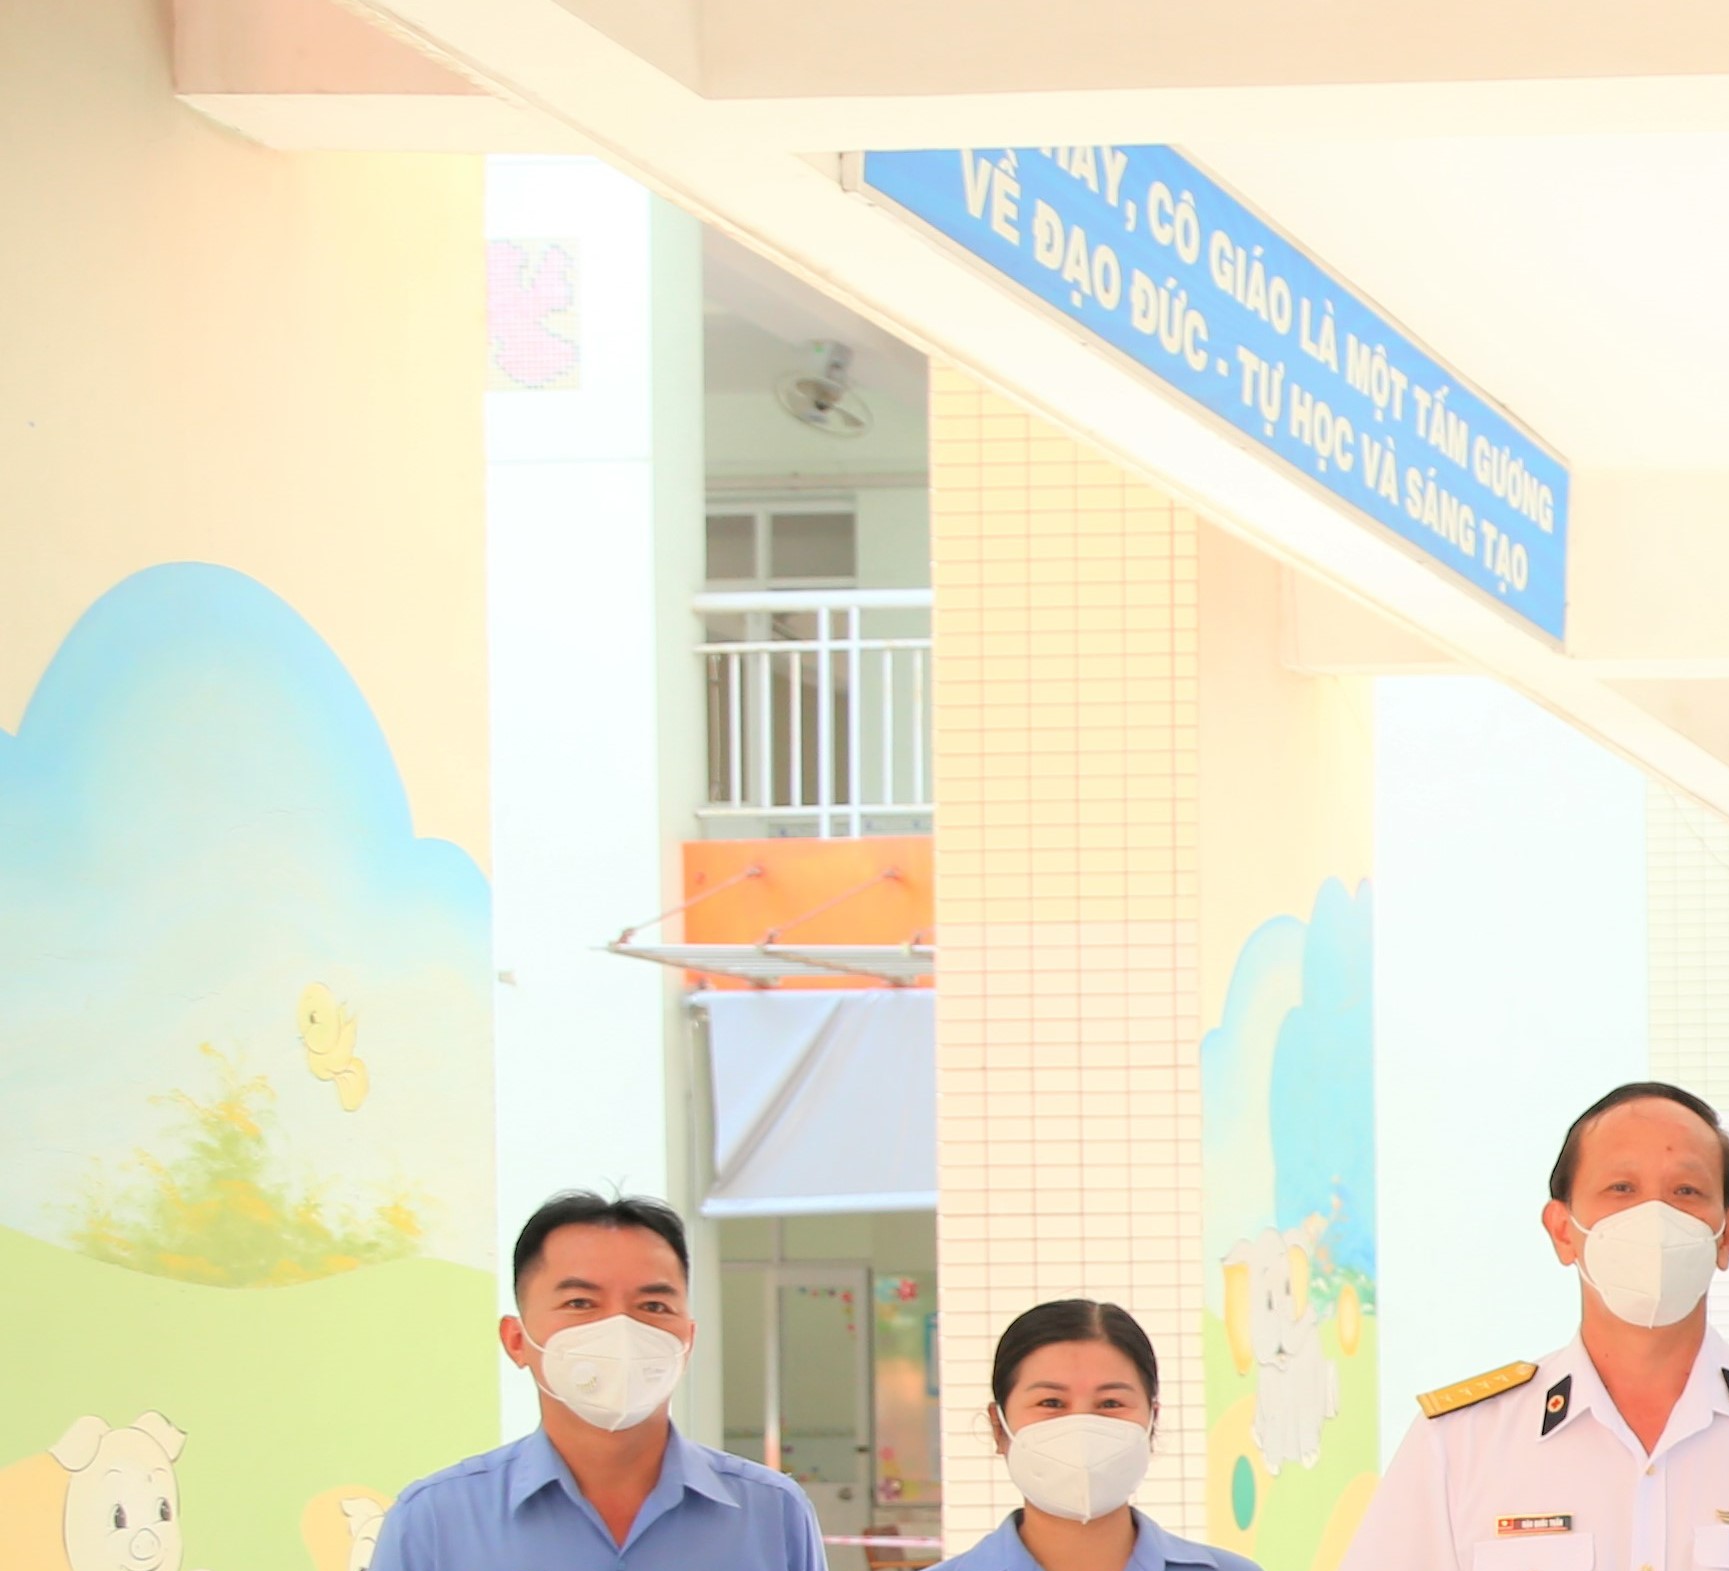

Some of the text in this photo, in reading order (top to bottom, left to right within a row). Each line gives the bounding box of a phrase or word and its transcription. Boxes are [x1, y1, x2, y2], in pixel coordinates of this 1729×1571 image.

[962, 148, 1020, 246] VỀ
[1033, 198, 1122, 311] ĐẠO
[1130, 268, 1209, 371] ĐỨC
[1237, 345, 1285, 437] TỰ
[1290, 382, 1354, 472] HỌC
[1361, 432, 1399, 506] VÀ
[1405, 466, 1475, 557] SÁNG
[1481, 518, 1528, 593] TẠO
[1147, 181, 1200, 264] CÔ
[1209, 230, 1292, 335] GIÁO
[1300, 297, 1339, 373] LÀ
[1346, 333, 1408, 423] MỘT
[1414, 384, 1469, 469] TẤM
[1474, 435, 1554, 533] GƯƠNG
